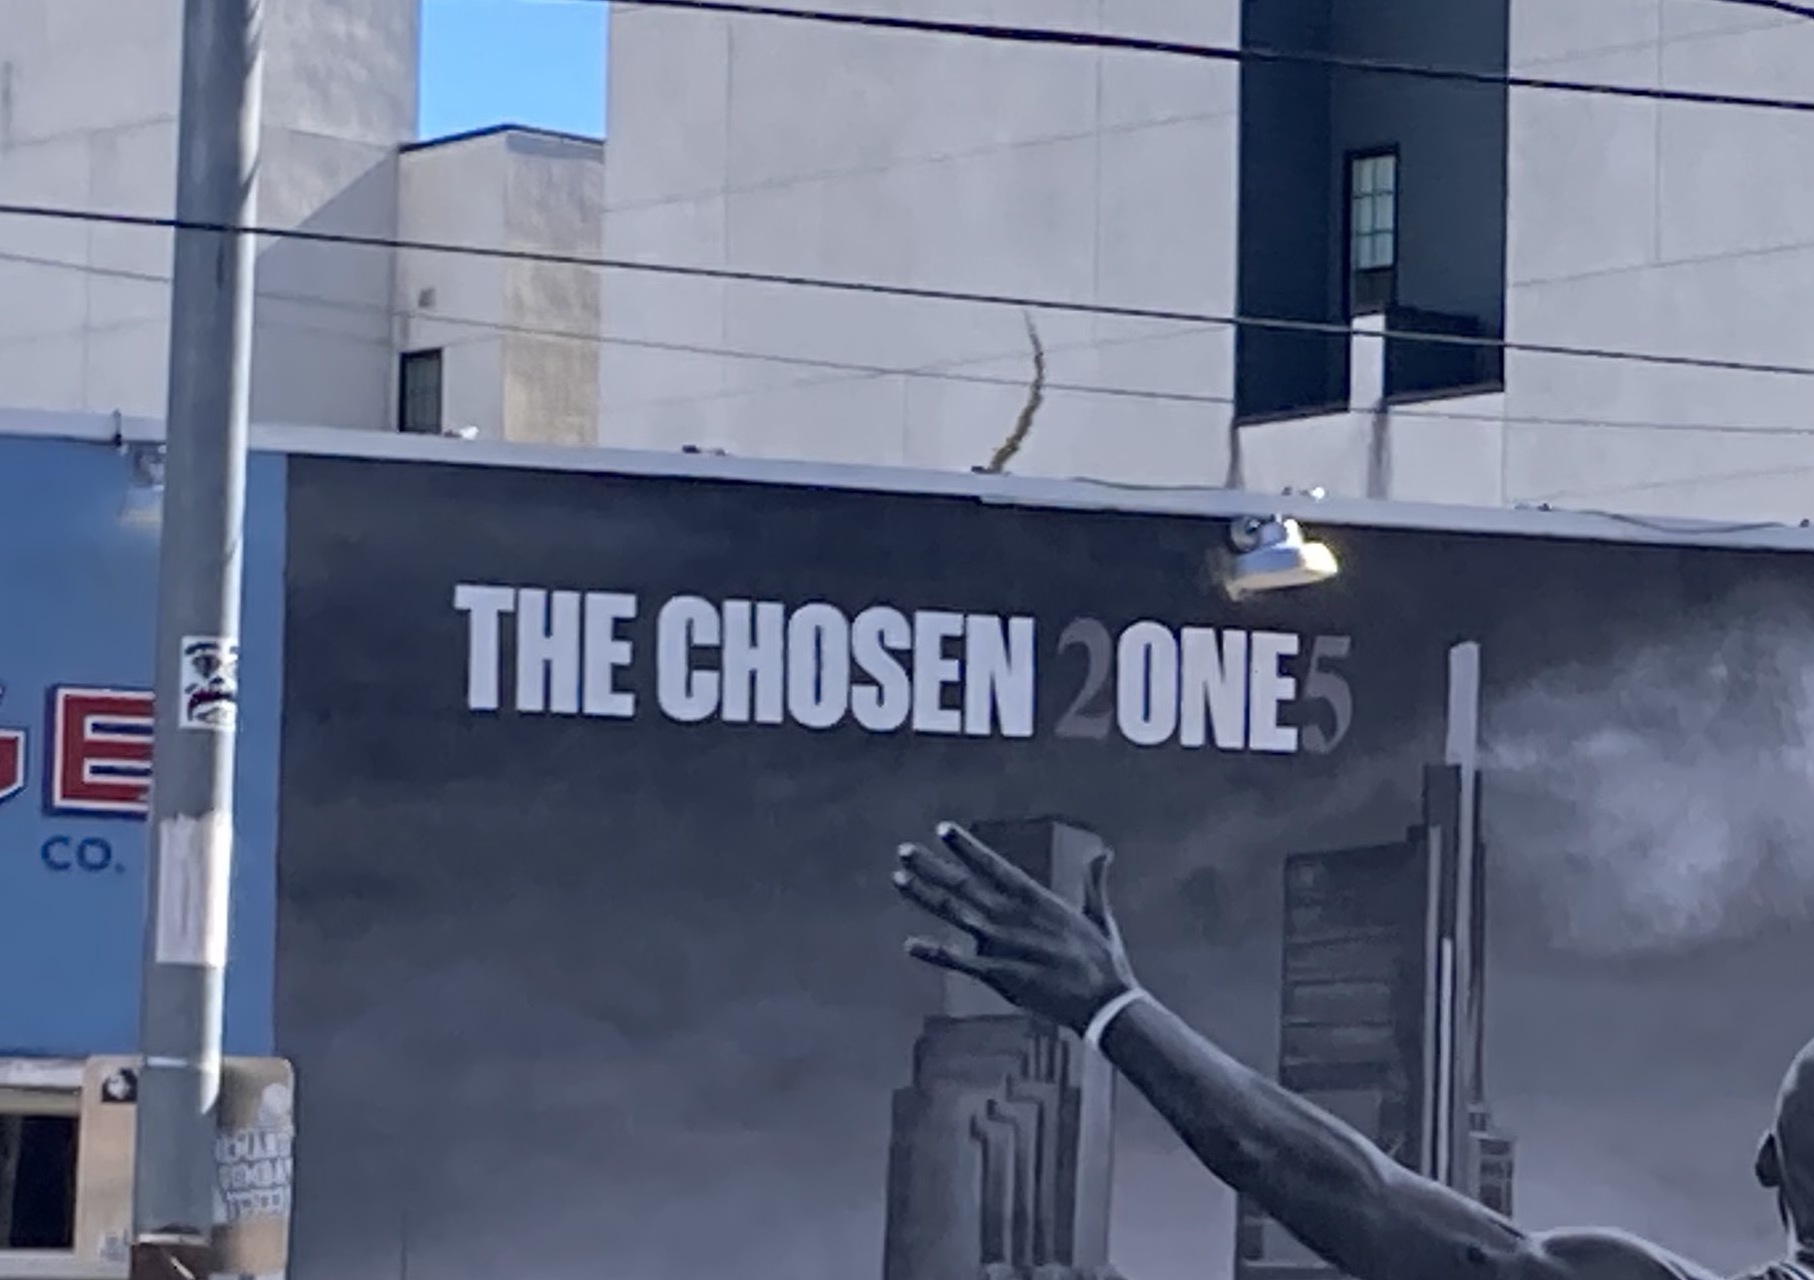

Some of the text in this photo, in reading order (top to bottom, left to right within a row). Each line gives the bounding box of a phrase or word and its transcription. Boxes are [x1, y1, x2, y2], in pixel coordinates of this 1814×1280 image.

[453, 584, 637, 716] THE
[656, 595, 1036, 738] CHOSEN
[41, 834, 126, 873] CO.
